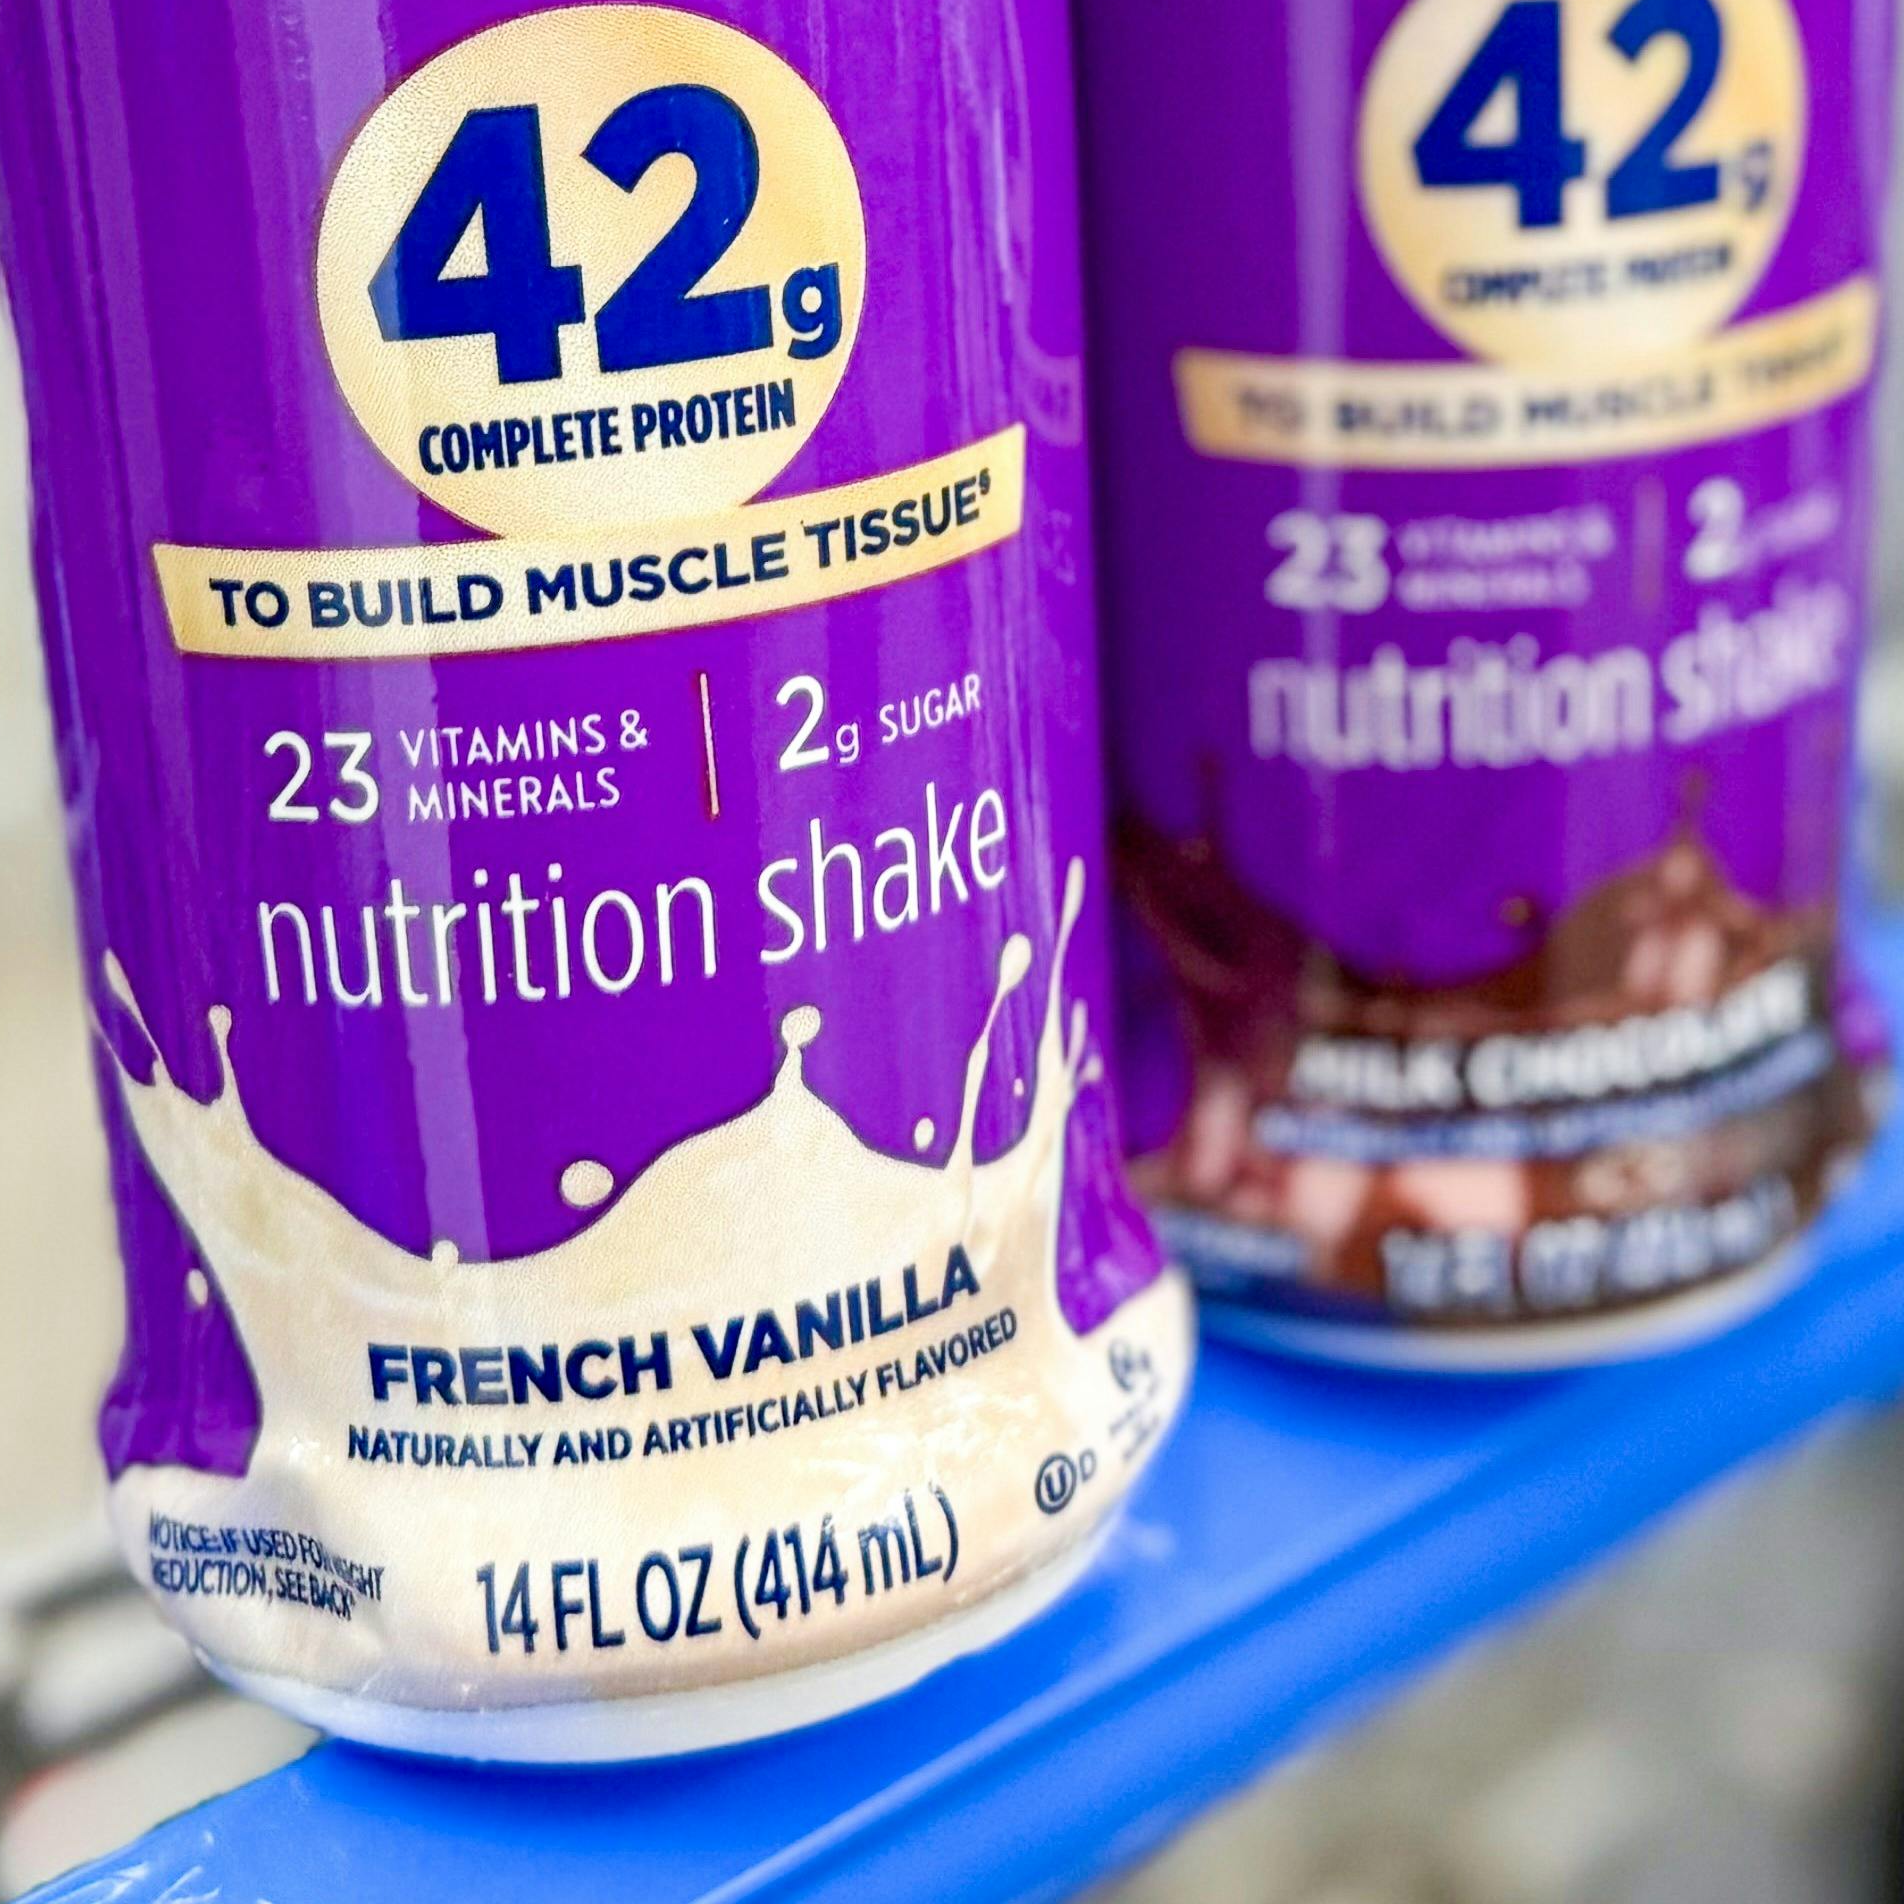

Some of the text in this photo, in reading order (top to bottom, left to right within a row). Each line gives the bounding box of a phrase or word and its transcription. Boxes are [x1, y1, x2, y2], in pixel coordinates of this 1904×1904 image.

[418, 379, 796, 475] COMPLETE PROTEIN
[210, 578, 289, 629] TO
[309, 572, 504, 630] BUILD
[526, 532, 790, 617] MUSCLE
[1264, 507, 1391, 615] 23
[879, 673, 981, 744] SUGAR
[1248, 632, 1654, 772] nutrition
[261, 709, 649, 824] 23 VITAMINS &
[407, 767, 622, 823] MINERALS
[257, 782, 1008, 1008] nutrition shake
[366, 1331, 673, 1406] FRENCH
[691, 1242, 982, 1381] VANILLA
[347, 1306, 1017, 1468] NATURALLY AND ARTIFICIALLY FLAVORED
[242, 1527, 297, 1561] USED
[274, 1566, 309, 1605] SEE
[475, 1479, 960, 1654] 14 FL OZ (414 mL)
